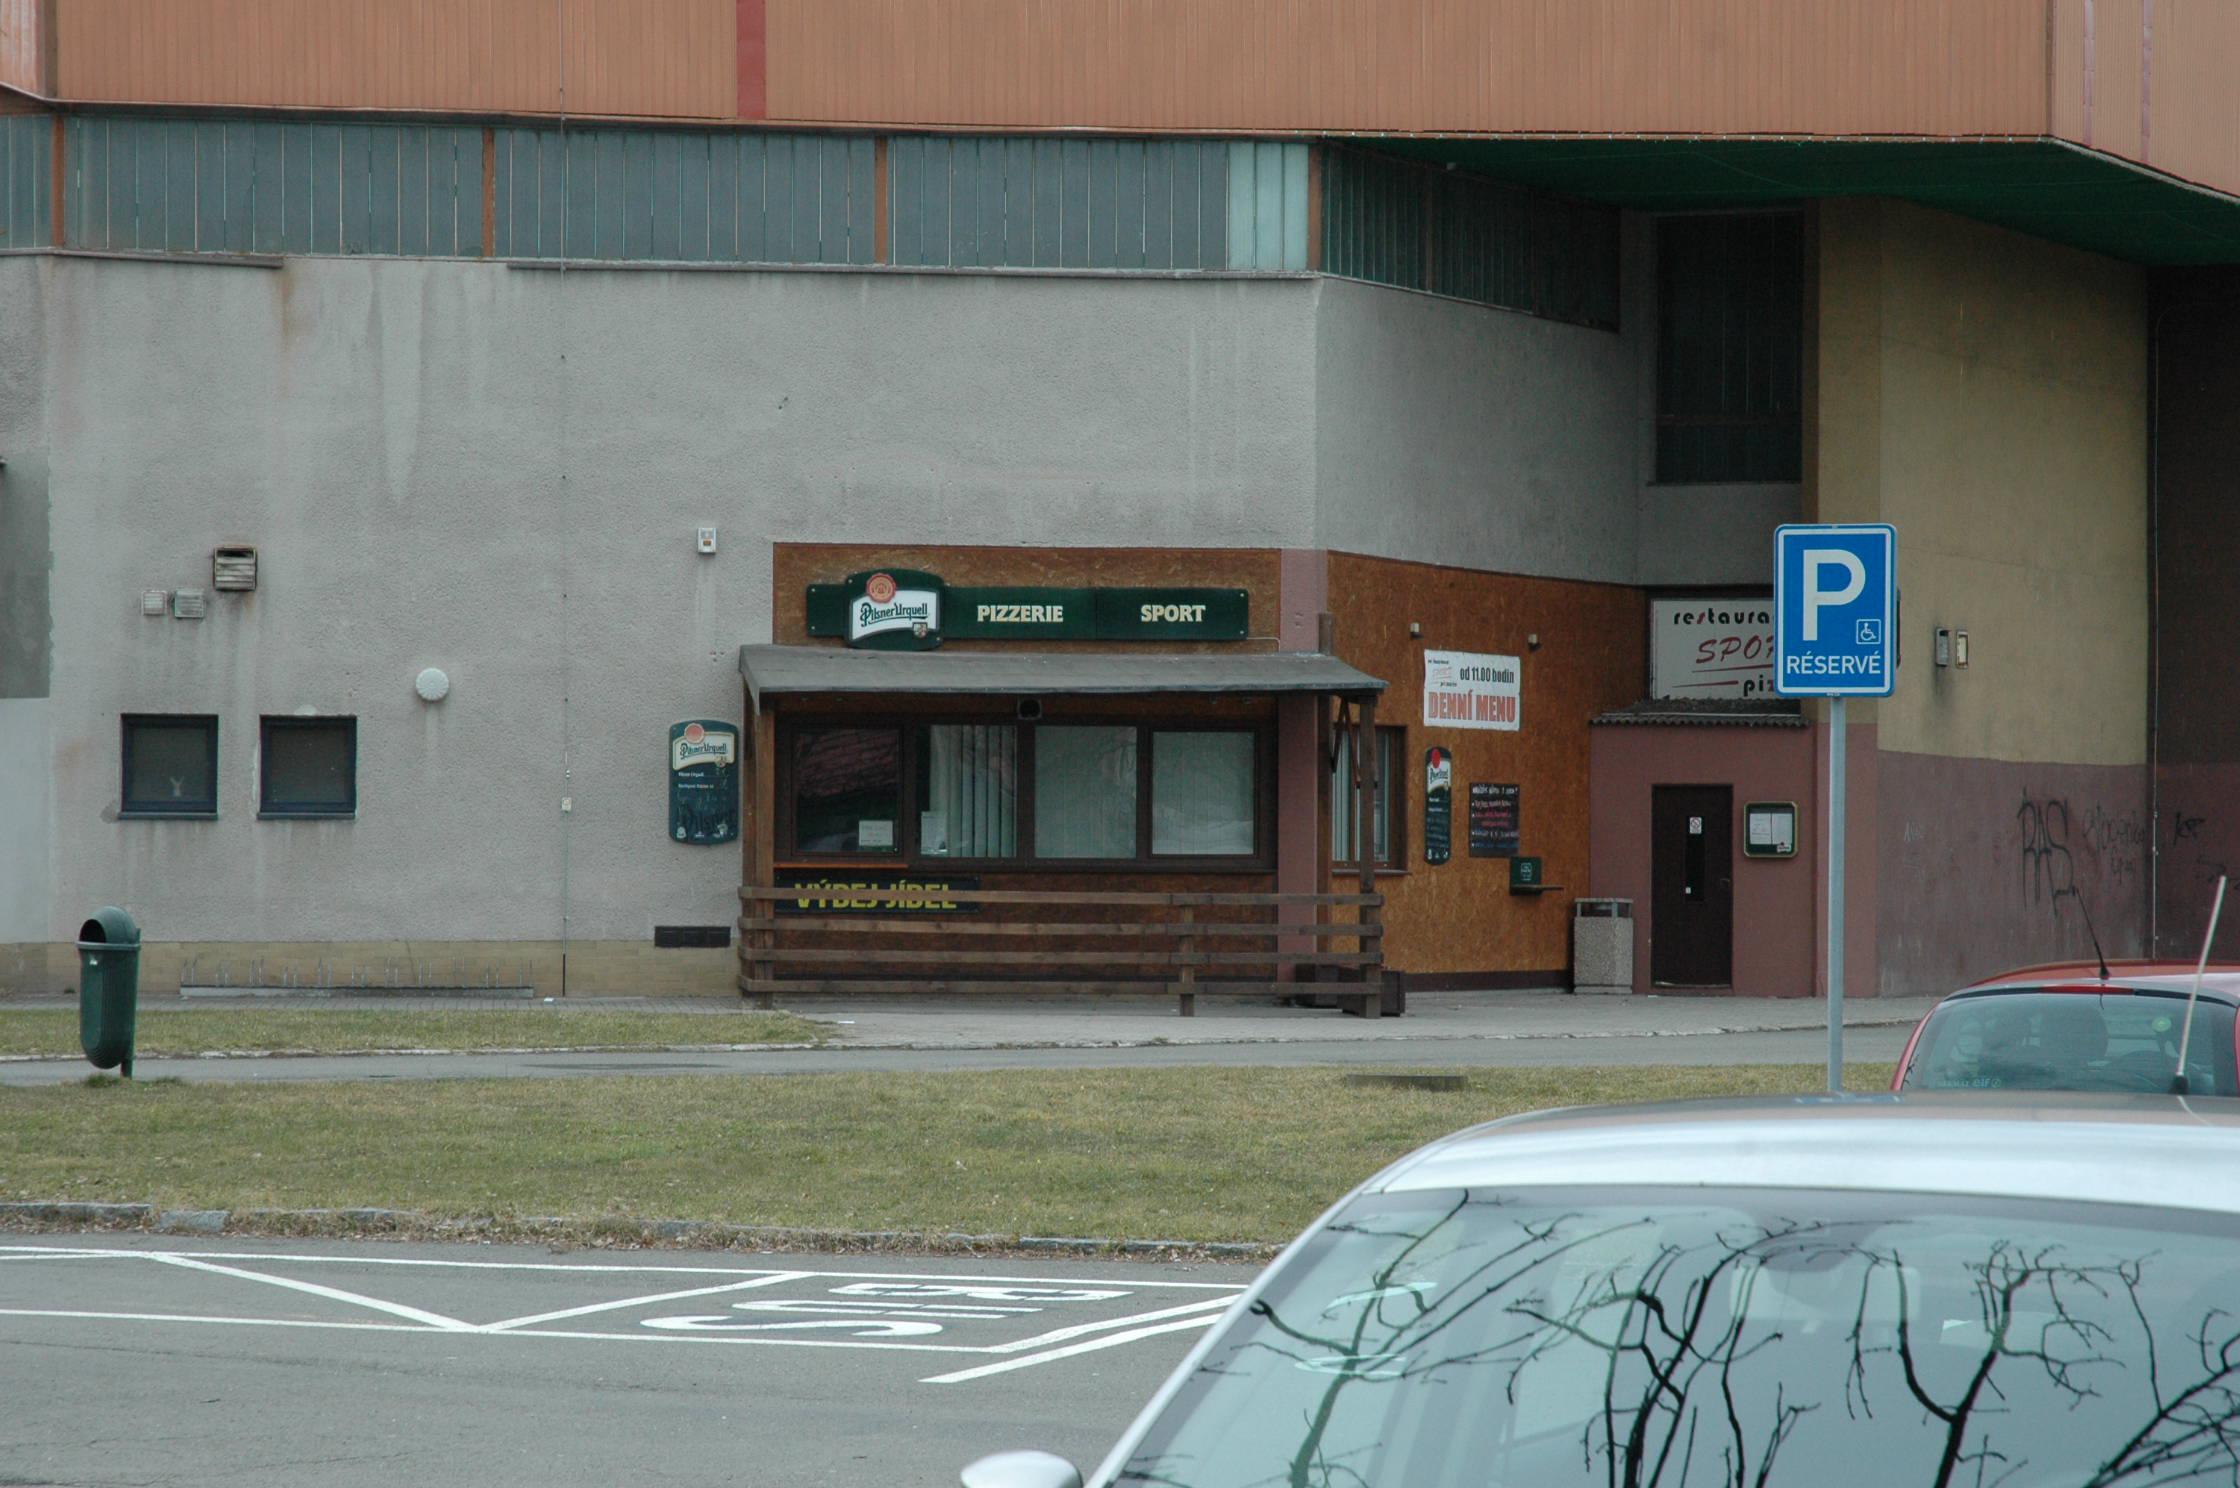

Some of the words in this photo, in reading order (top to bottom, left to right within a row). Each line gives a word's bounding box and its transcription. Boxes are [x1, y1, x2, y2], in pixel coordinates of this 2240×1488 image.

[1803, 549, 1866, 641] P
[860, 602, 895, 627] Pilsner
[894, 603, 928, 620] Urquell
[977, 605, 1063, 622] PIZZERIE
[1141, 604, 1206, 622] SPORT
[1673, 608, 1770, 625] restaura
[1459, 666, 1470, 681] od
[1472, 667, 1491, 682] 11.00
[1787, 651, 1881, 674] RÉSERVÉ
[1428, 688, 1473, 721] DENNÍ
[1475, 694, 1516, 723] MENU
[640, 1282, 1135, 1337] BUS
